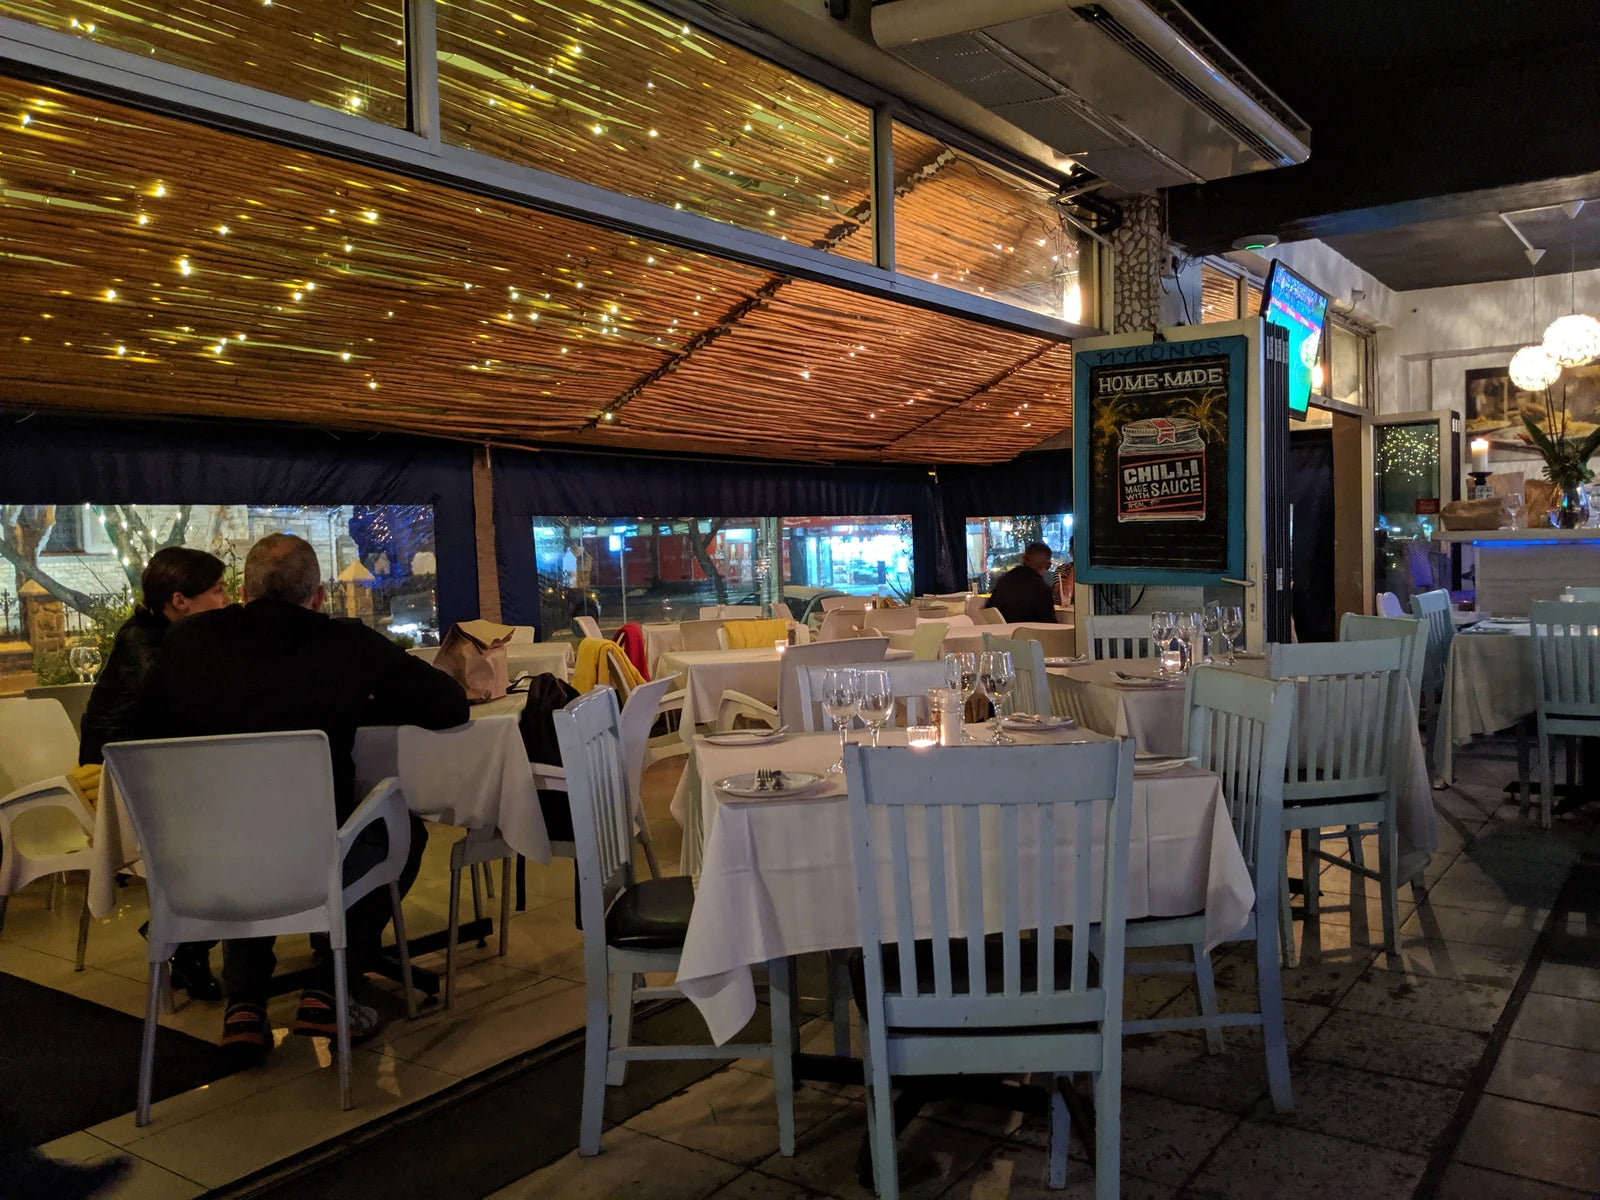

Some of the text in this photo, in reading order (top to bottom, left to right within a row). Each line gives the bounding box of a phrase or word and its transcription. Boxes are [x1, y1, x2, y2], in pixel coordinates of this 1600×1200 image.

[1096, 340, 1220, 364] MYKONOS
[1098, 368, 1223, 393] HOME-MADE
[1123, 459, 1199, 485] CHILLI
[1124, 483, 1149, 494] MADE
[1126, 491, 1151, 501] WITH
[1150, 477, 1202, 497] SAUCE
